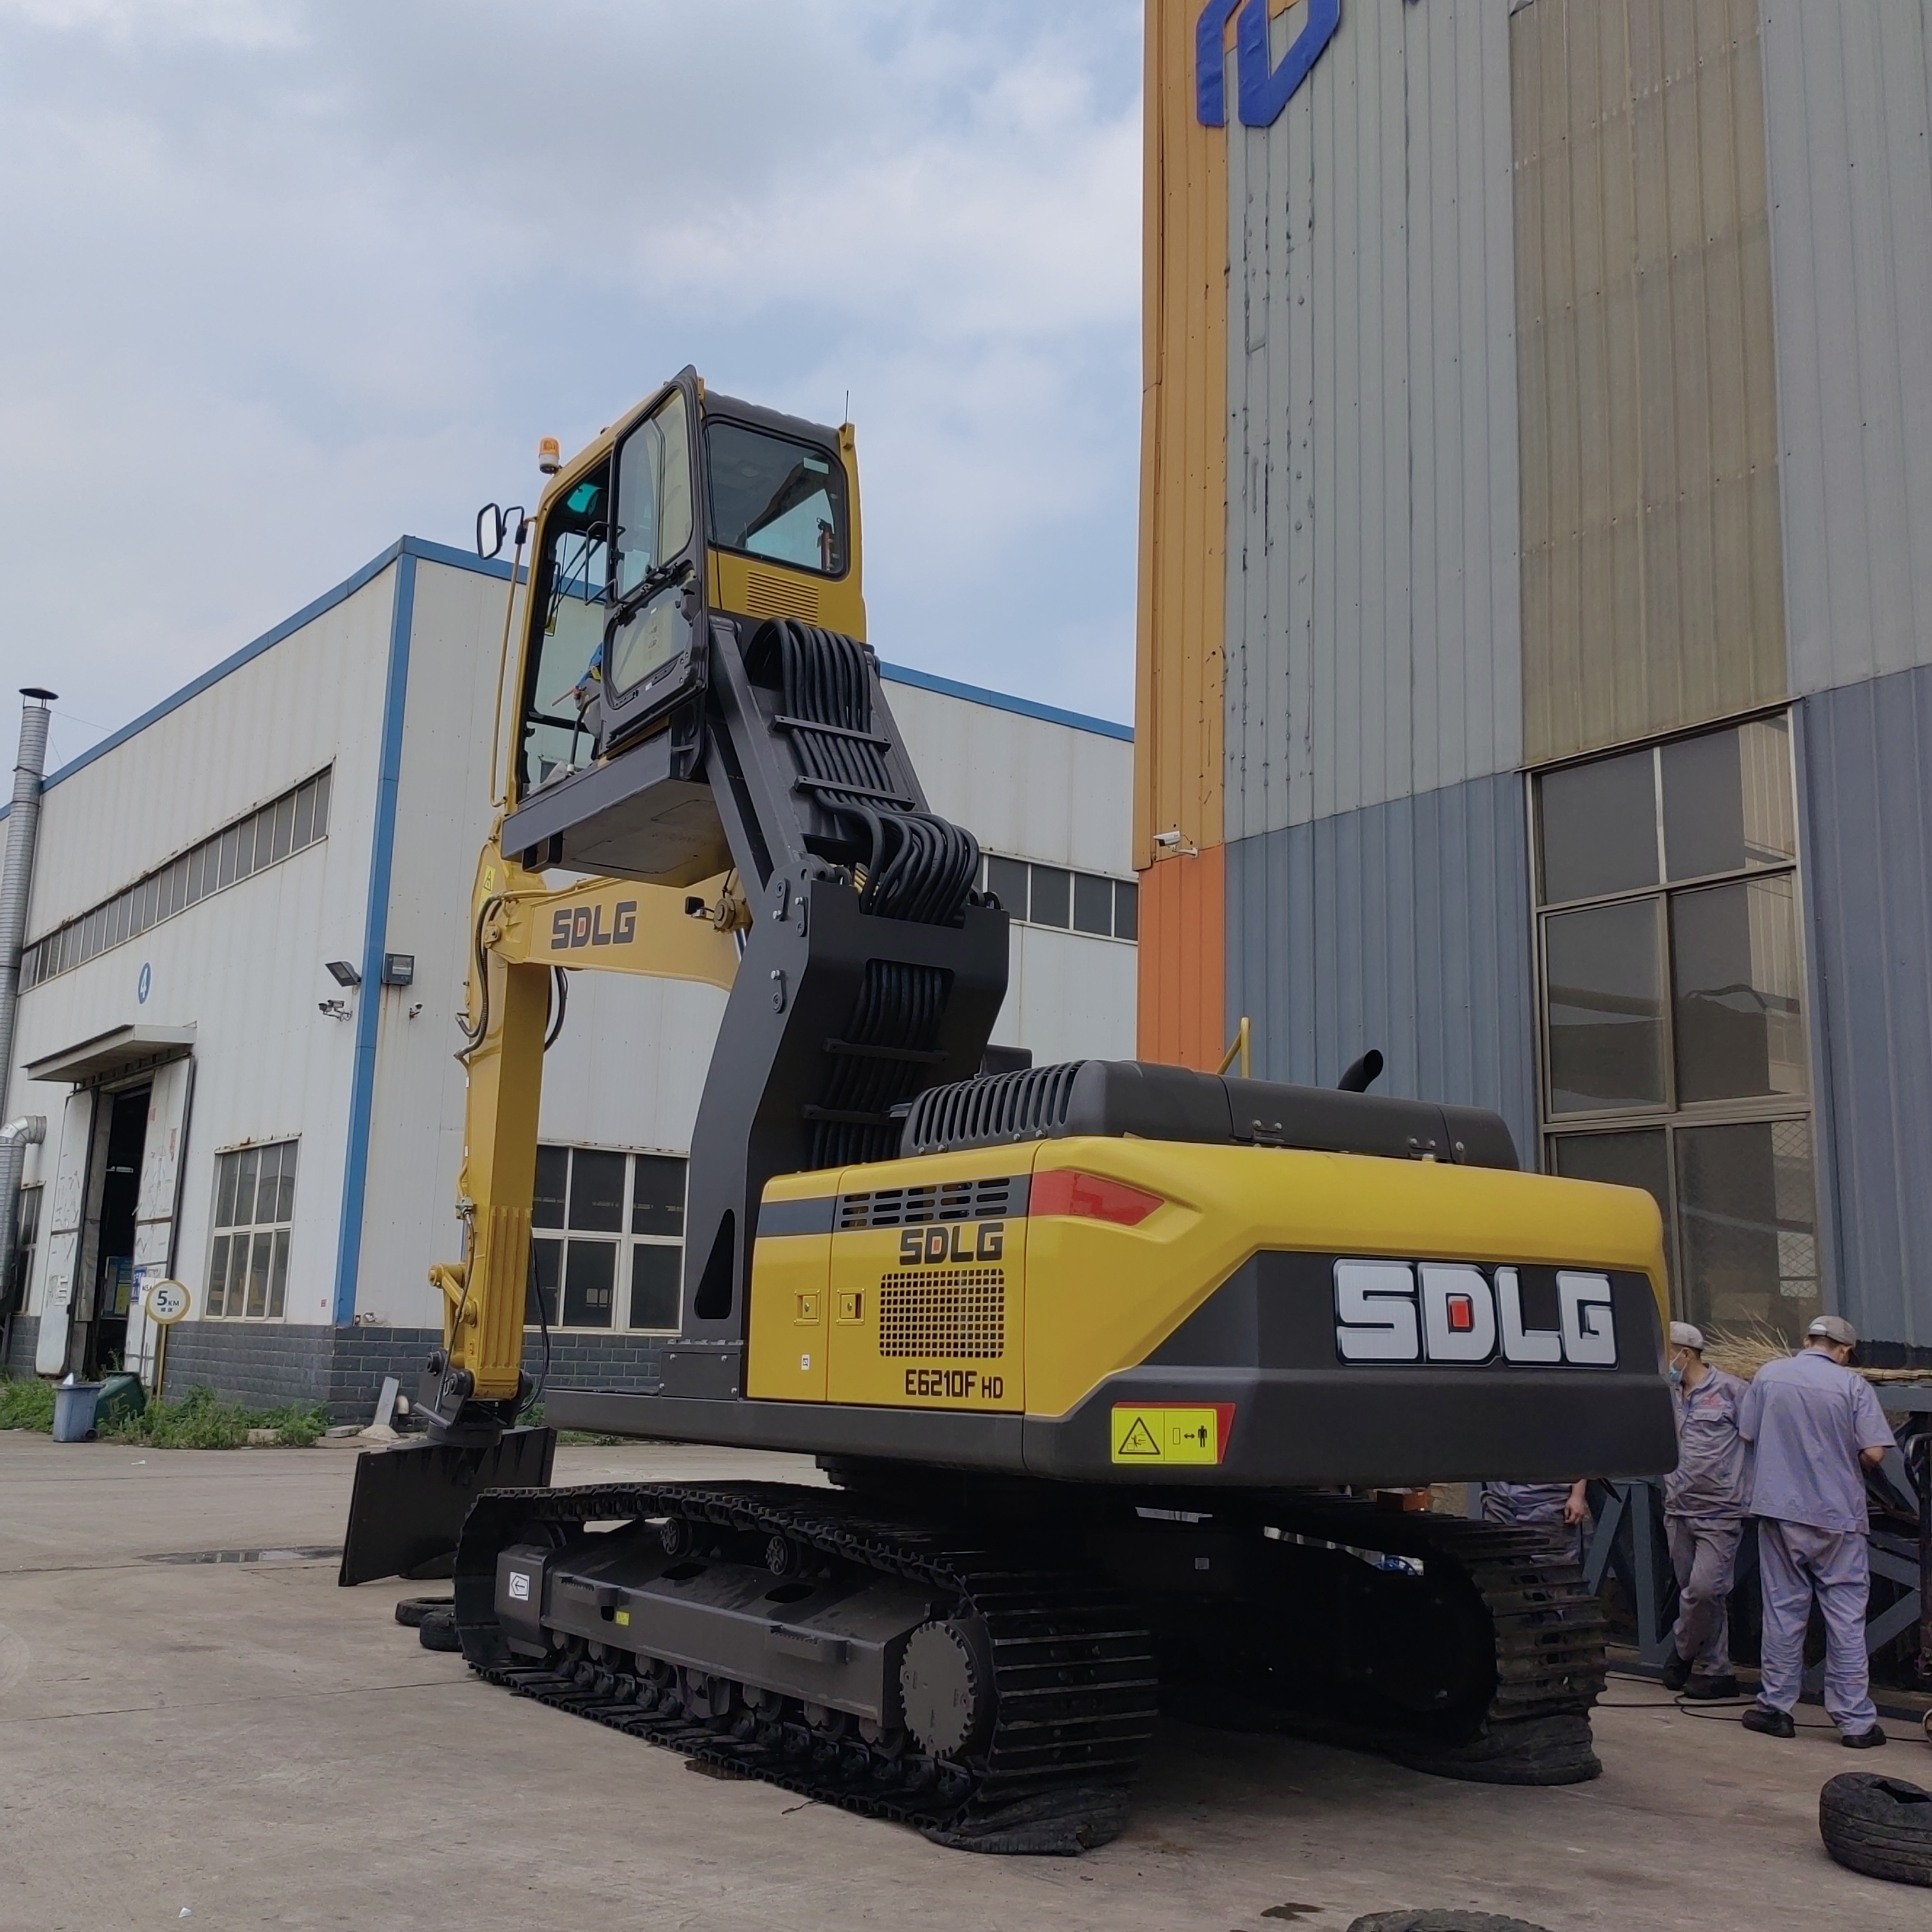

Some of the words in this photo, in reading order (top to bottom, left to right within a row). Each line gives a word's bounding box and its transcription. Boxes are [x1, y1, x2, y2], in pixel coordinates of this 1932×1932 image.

[551, 901, 637, 950] SDLG
[899, 1222, 1004, 1265] SDLG
[1333, 1258, 1618, 1367] SDLG
[906, 1369, 977, 1398] E6210F
[982, 1376, 1003, 1399] HD
